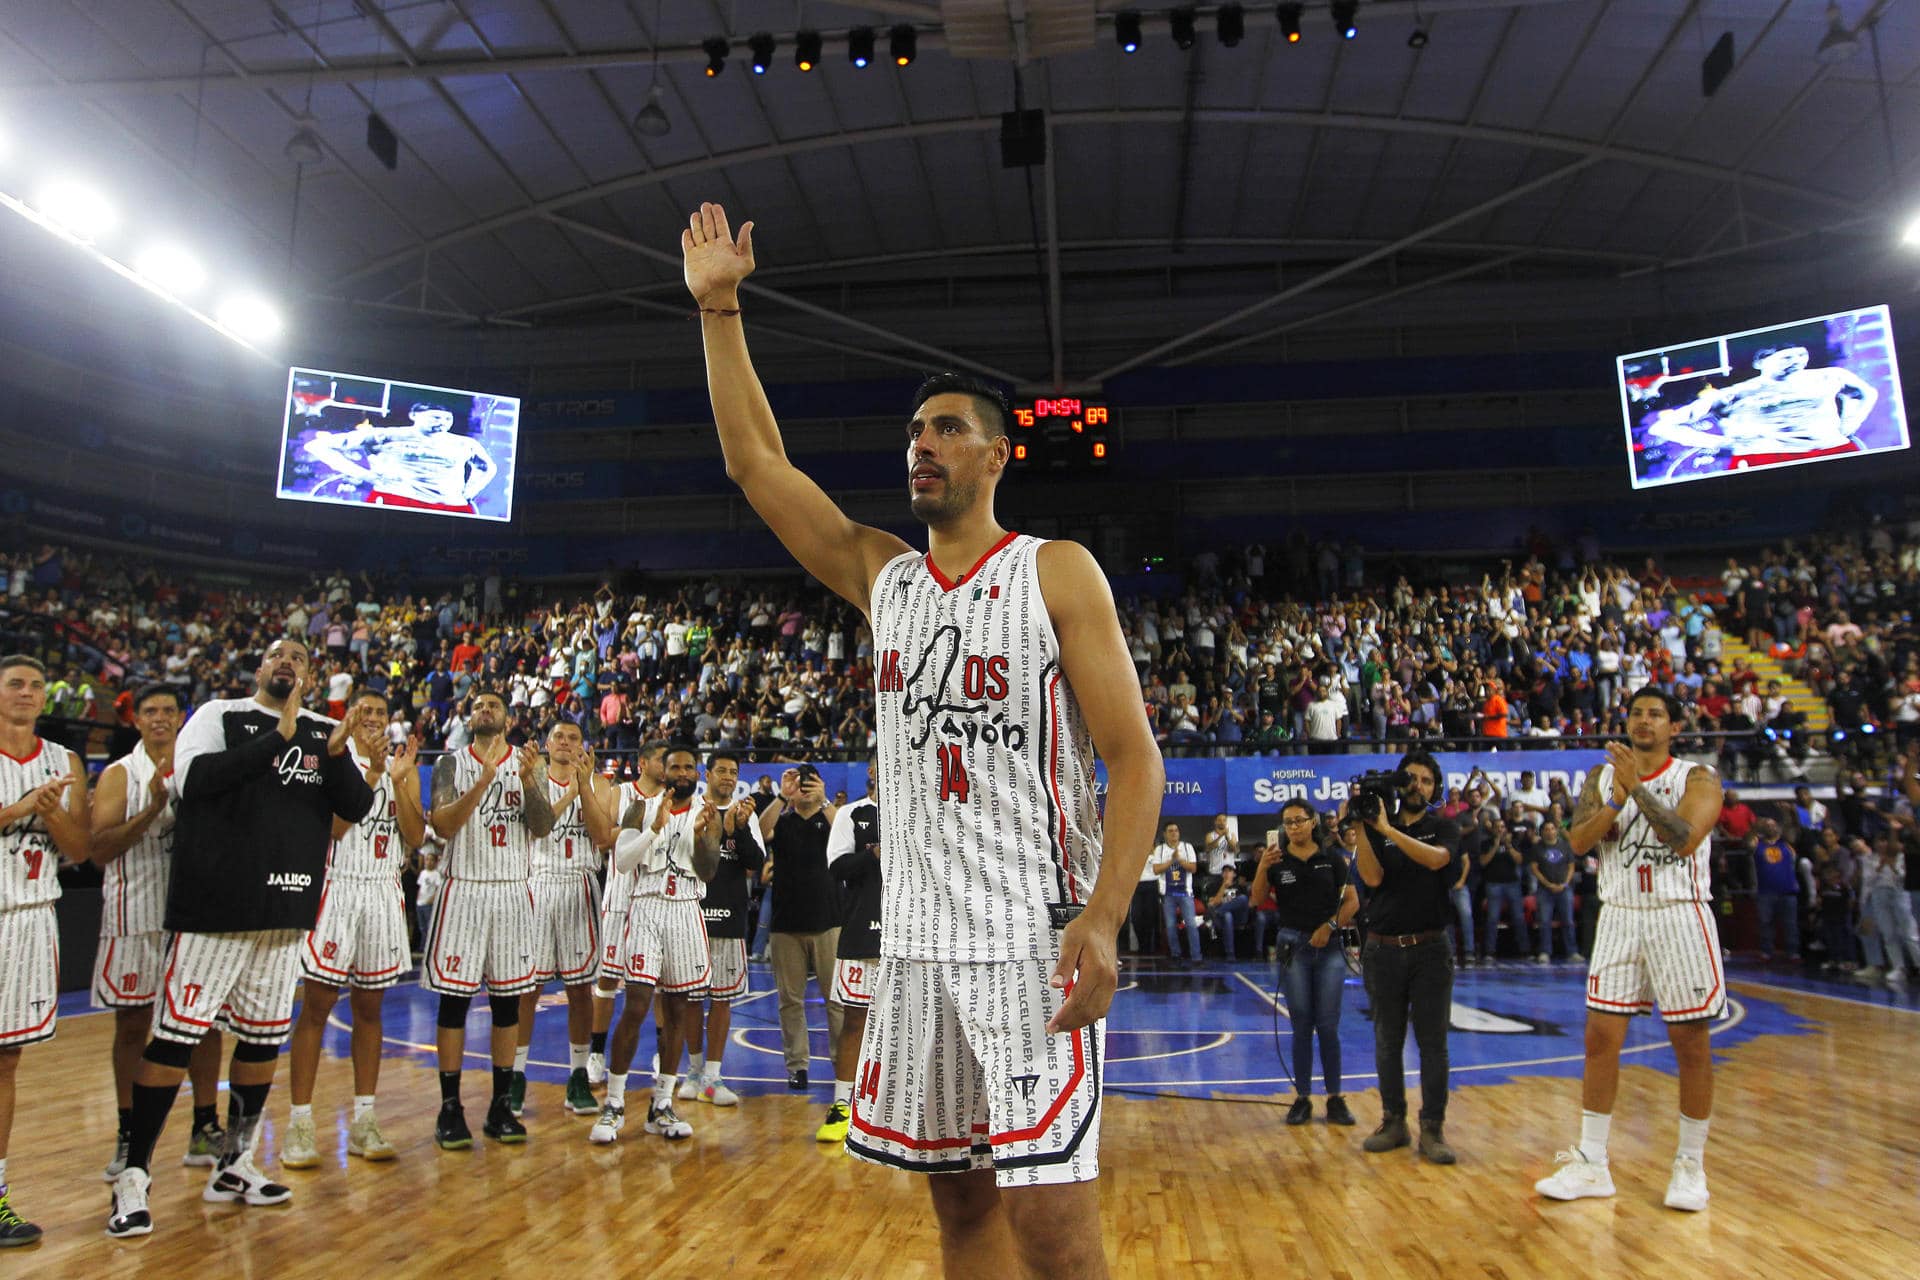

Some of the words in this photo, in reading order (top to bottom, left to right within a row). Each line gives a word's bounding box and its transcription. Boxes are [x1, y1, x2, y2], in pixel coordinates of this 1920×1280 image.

[1014, 409, 1034, 427] 75
[1085, 407, 1108, 425] 89
[1035, 398, 1081, 417] 04:54
[1071, 420, 1083, 433] 4
[1015, 445, 1026, 459] 0
[1094, 443, 1105, 457] 0
[1020, 580, 1030, 652] CENTROBASKET,
[962, 616, 974, 646] 2018-19
[982, 622, 991, 643] LIGA
[1001, 611, 1010, 649] MADRID
[1020, 654, 1030, 692] 2014-15
[1020, 695, 1030, 718] REAL
[936, 742, 969, 804] 14
[1006, 751, 1017, 788] MADRID
[1273, 769, 1317, 779] HOSPITAL
[988, 775, 998, 798] COPA
[1023, 762, 1038, 814] SUPERCOPA
[1164, 782, 1202, 794] TRIA
[1254, 779, 1308, 802] San
[973, 793, 983, 829] 2018-19
[991, 800, 1001, 817] DEL
[1011, 791, 1021, 814] COPA
[908, 797, 918, 835] MADRID
[953, 800, 965, 844] CAMPEÓN
[992, 819, 1003, 837] REY,
[489, 825, 507, 847] 12
[975, 832, 985, 854] REAL
[956, 846, 972, 894] NACIONAL
[1013, 817, 1033, 903] INTERCONTINENTAL,
[267, 873, 311, 885] JALISCO
[978, 856, 992, 893] MADRID
[1000, 874, 1010, 897] REAL
[1037, 863, 1049, 885] REAL
[1637, 864, 1653, 893] 11
[702, 909, 731, 918] ALISCO
[964, 896, 976, 939] ALIANZA
[985, 895, 994, 916] LIGA
[948, 898, 958, 948] HALCONES
[986, 918, 995, 940] ACB,
[1027, 906, 1037, 944] 2015-16
[445, 955, 461, 972] 12
[631, 954, 645, 971] 15
[848, 967, 863, 984] 22
[122, 973, 138, 992] 10
[932, 967, 942, 994] 2009
[950, 965, 961, 988] REY,
[1589, 975, 1599, 994] 11
[183, 983, 201, 1007] 17
[892, 979, 903, 1004] ACB,
[1017, 981, 1029, 1021] TELCEL
[890, 1006, 901, 1048] 2016-17
[934, 995, 944, 1045] MARINOS
[999, 987, 1011, 1045] NACIONAL
[1037, 960, 1050, 1003] 2007-08
[1049, 1078, 1059, 1095] DE
[934, 1046, 944, 1059] DE
[1019, 1023, 1033, 1063] UPAEP,
[888, 1051, 899, 1077] REAL
[905, 1063, 914, 1087] ACB,
[955, 1041, 965, 1095] HALCONES
[859, 1058, 882, 1105] 14
[935, 1061, 945, 1126] ANZOATEGUI
[1086, 1073, 1094, 1102] LIGA
[884, 1080, 897, 1123] MADRID
[904, 1090, 912, 1116] 2015
[955, 1096, 964, 1110] DE
[917, 1102, 927, 1140] MADRID
[1072, 1155, 1082, 1183] LIGA
